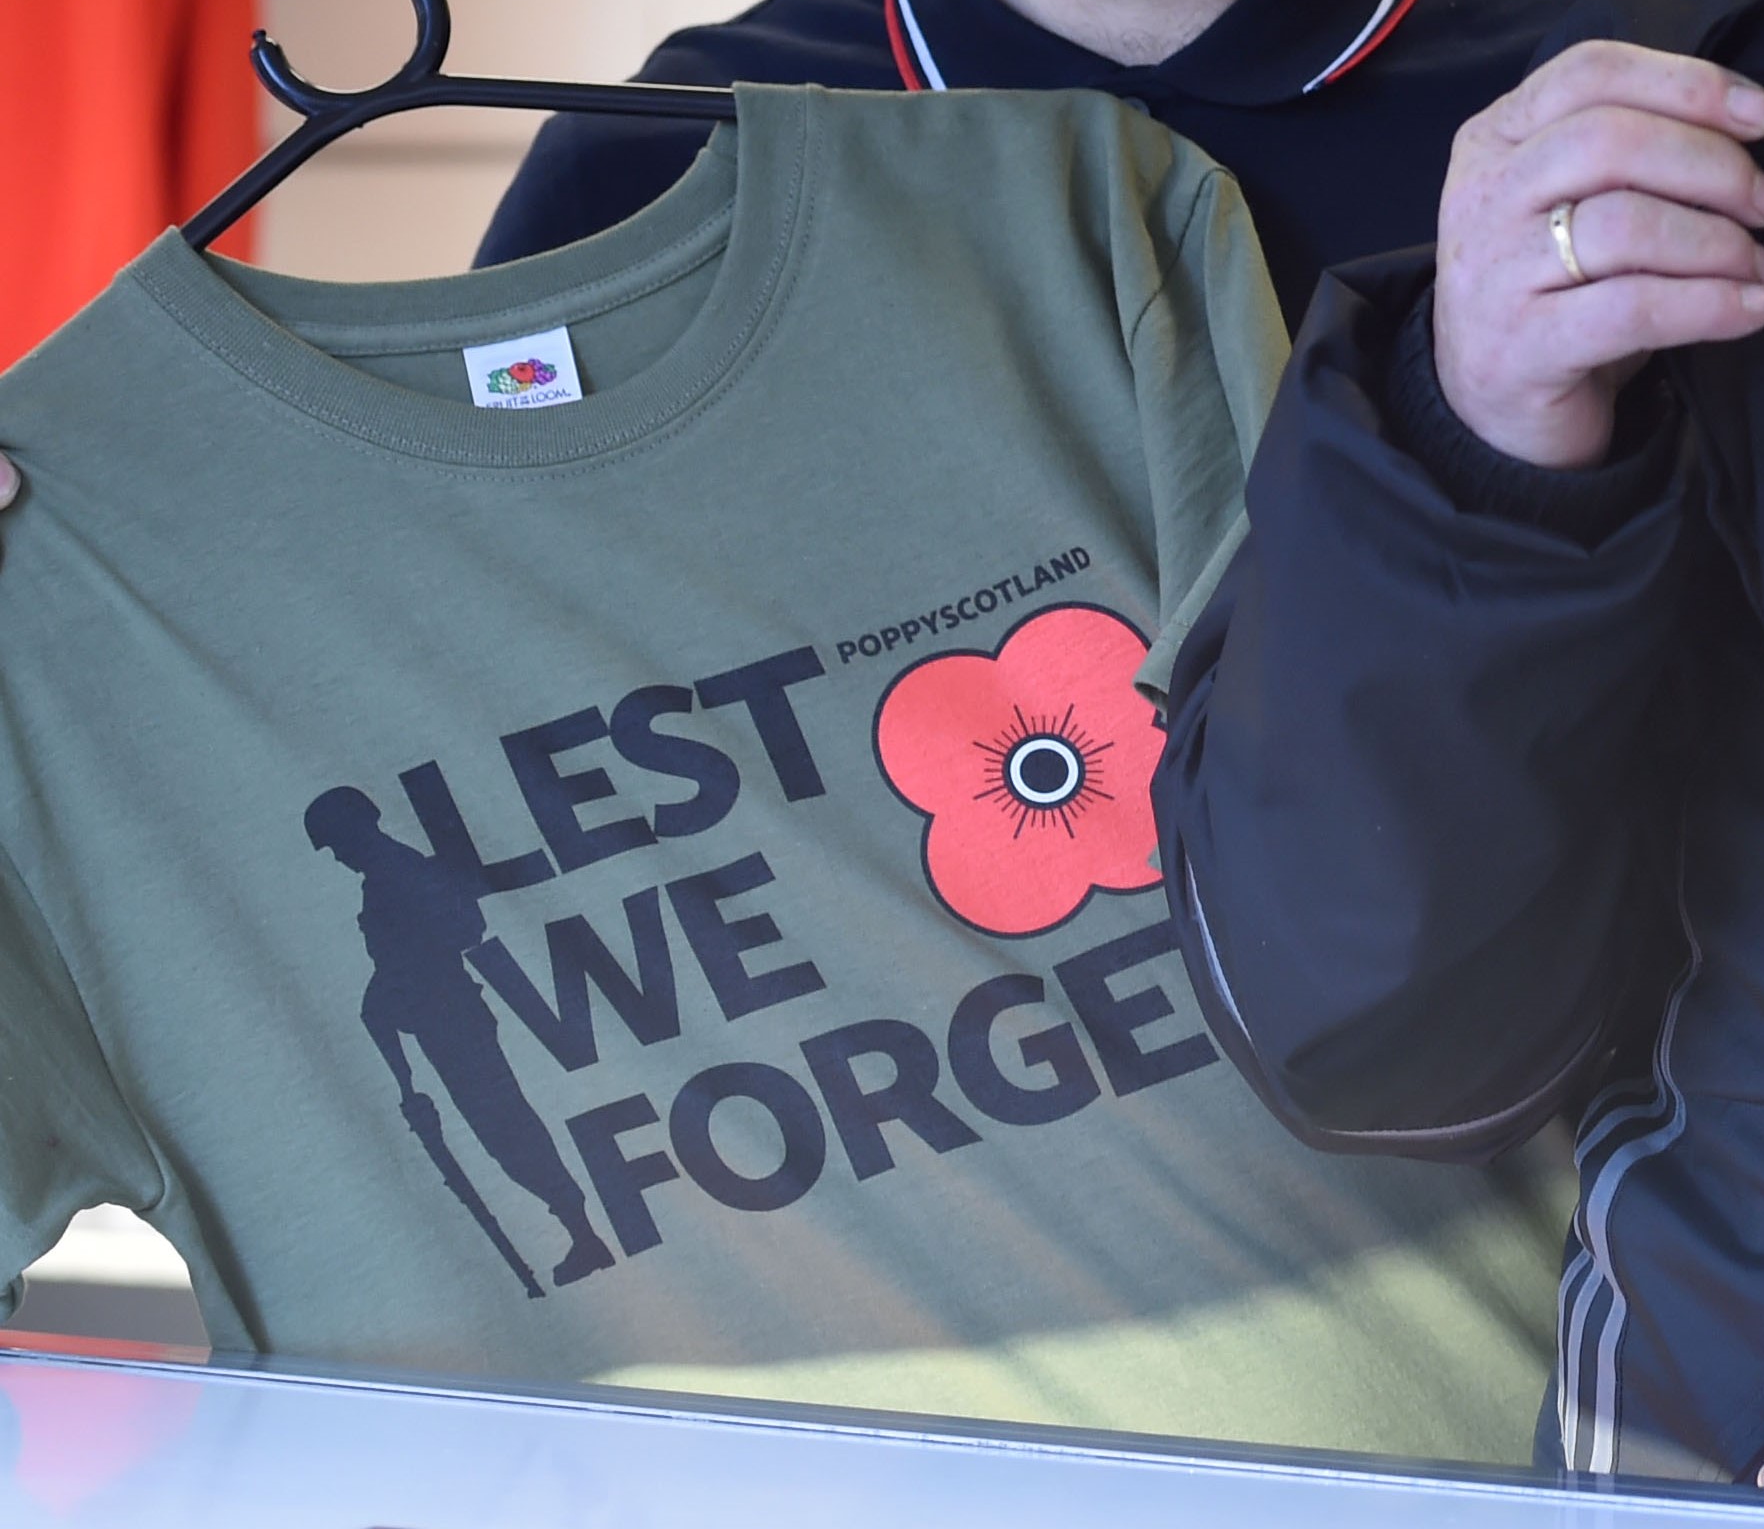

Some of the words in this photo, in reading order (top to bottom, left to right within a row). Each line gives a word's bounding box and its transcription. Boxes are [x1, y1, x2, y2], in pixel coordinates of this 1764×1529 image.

[836, 546, 1092, 664] POPPYSCOTLAND
[399, 645, 826, 899] LEST
[462, 851, 827, 1073] WE
[564, 917, 1220, 1257] FORGE
